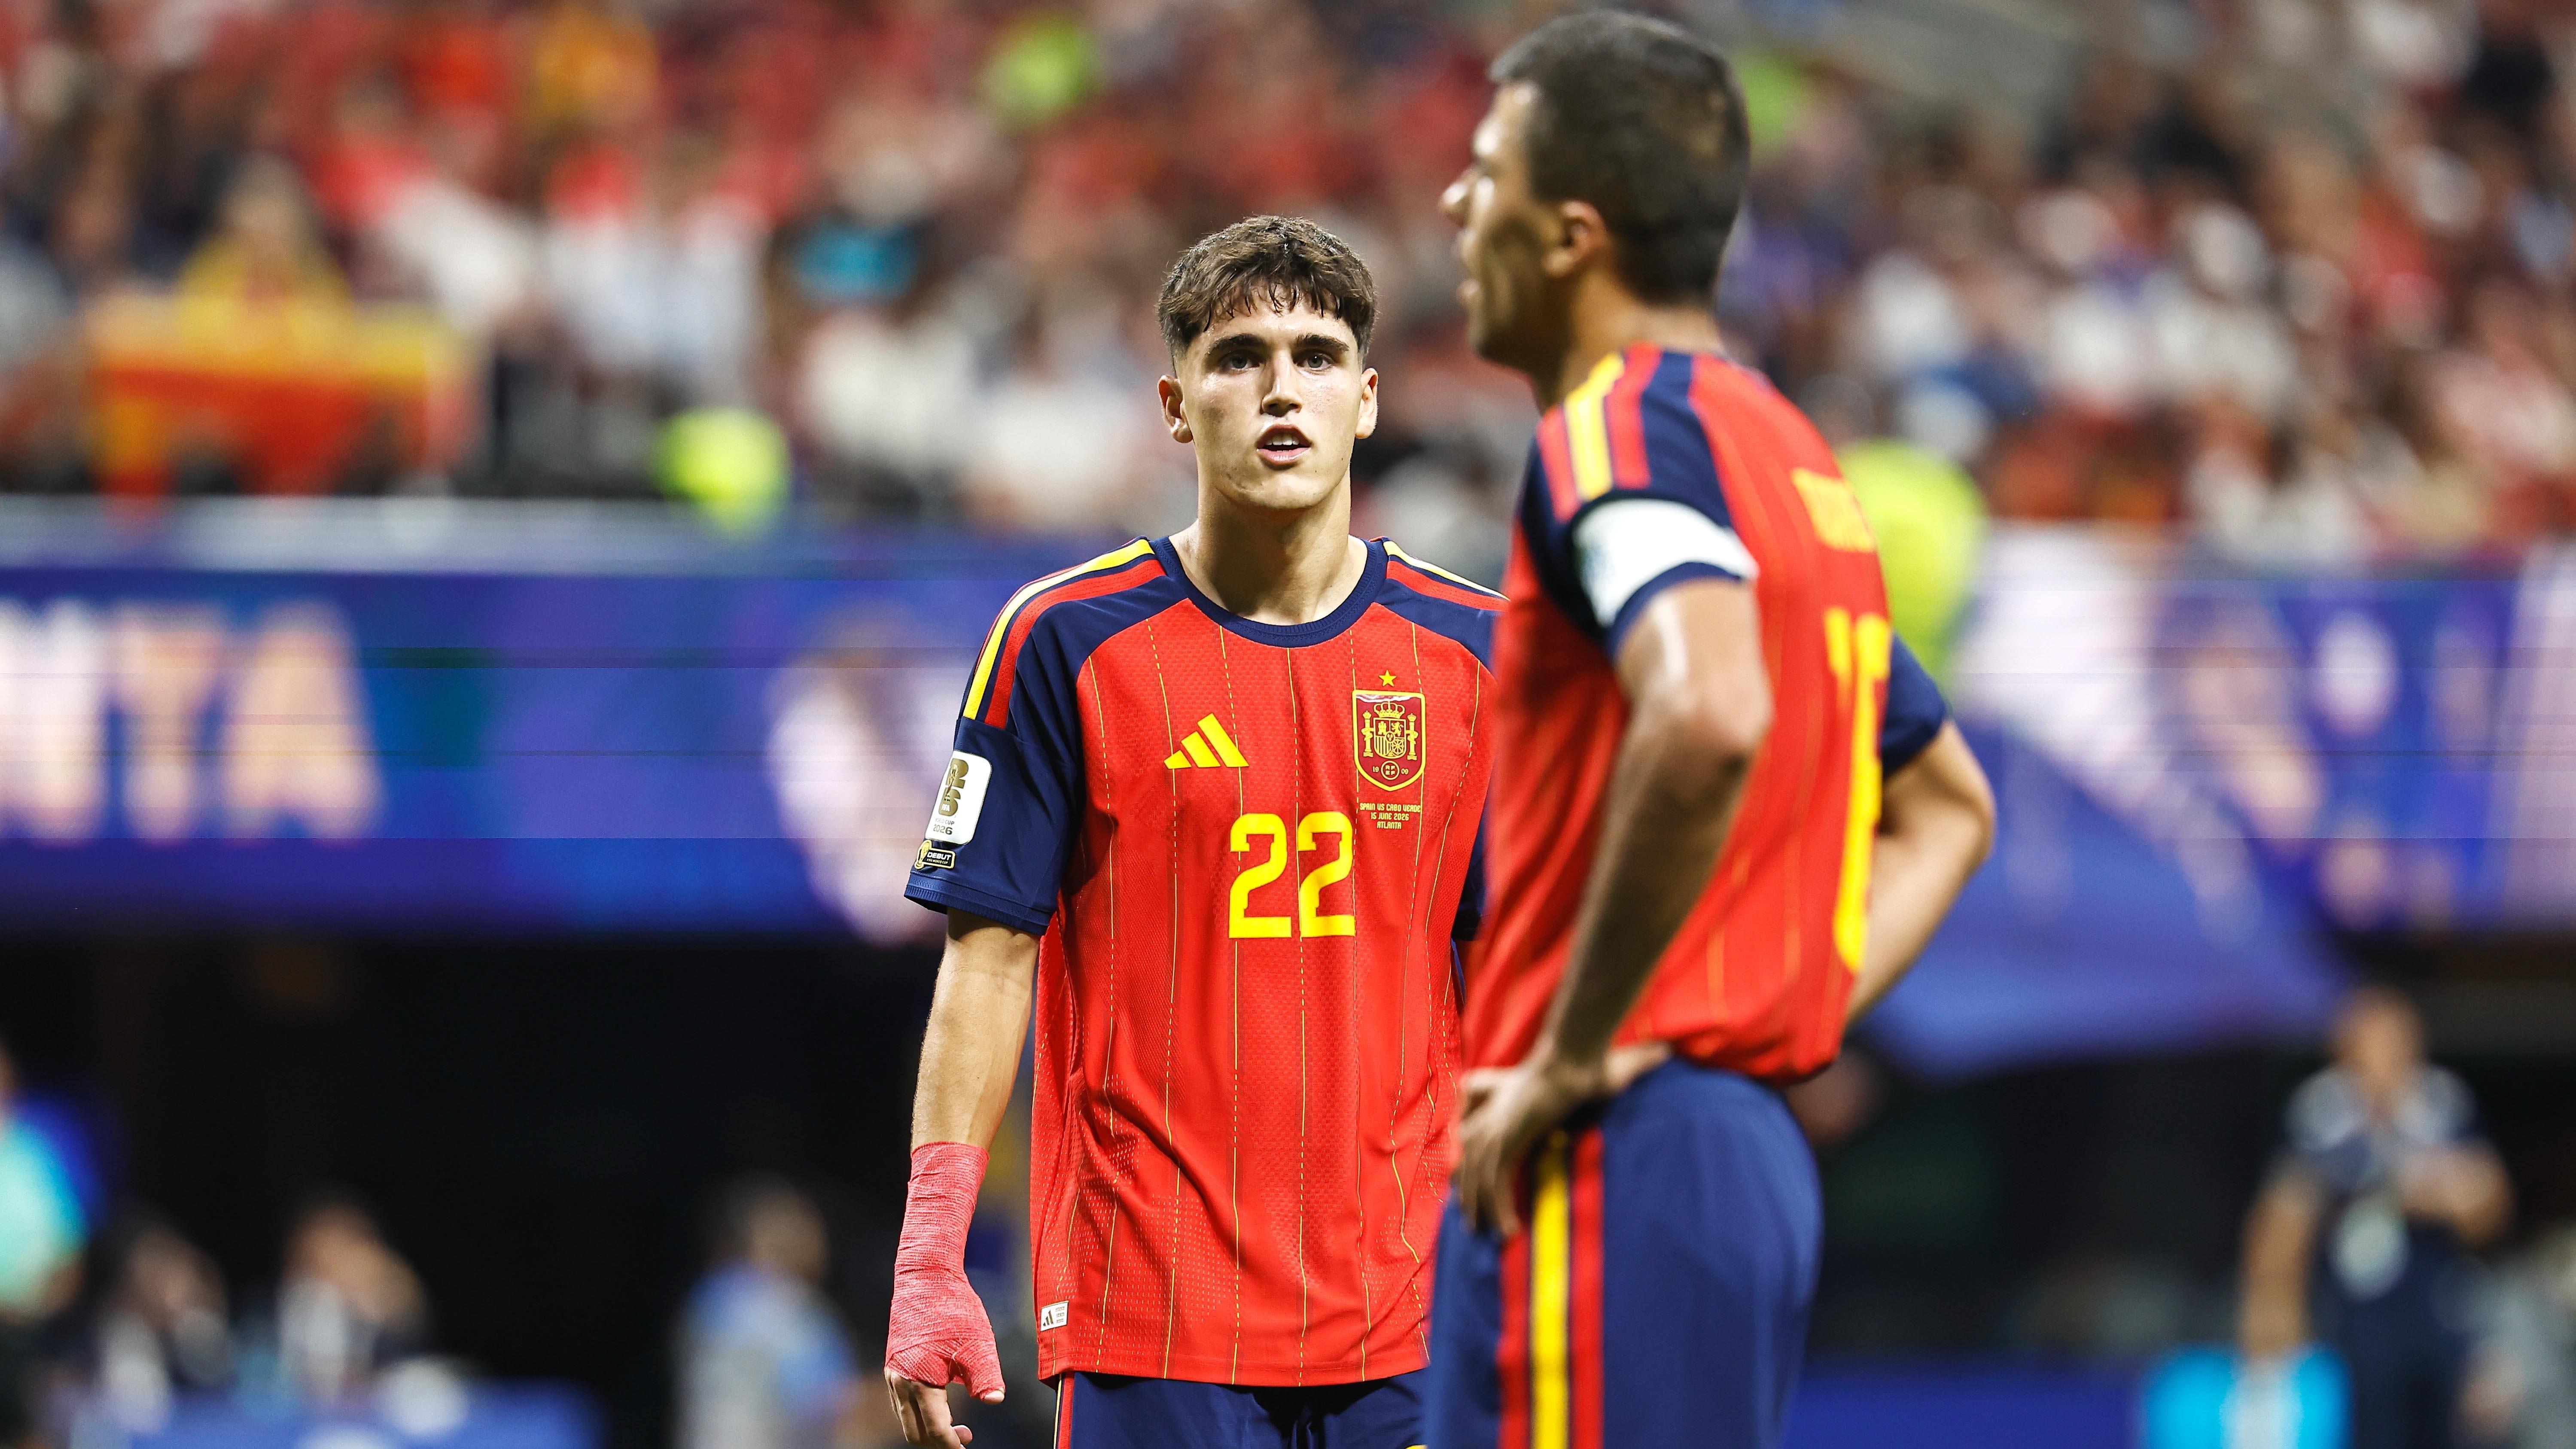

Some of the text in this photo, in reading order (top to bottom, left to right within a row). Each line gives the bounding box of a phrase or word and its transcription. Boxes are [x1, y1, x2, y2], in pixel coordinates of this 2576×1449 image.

[1386, 804, 1401, 812] CABO
[1403, 804, 1421, 813] VERDE
[933, 824, 953, 835] 2026
[1377, 821, 1401, 829] ATLANTA
[927, 852, 951, 861] DEBUT
[1229, 812, 1355, 938] 22
